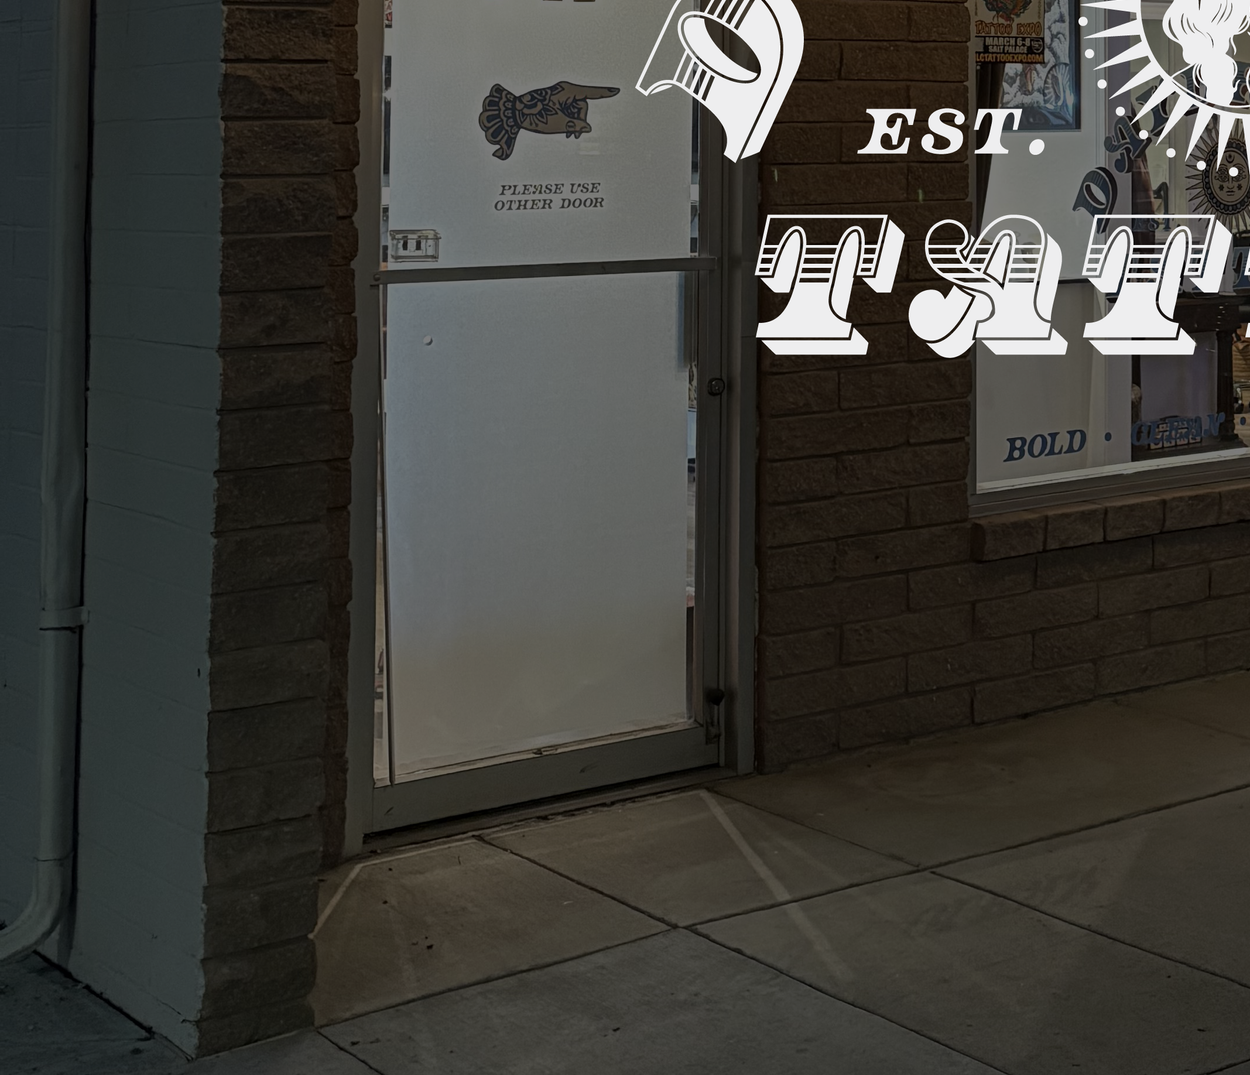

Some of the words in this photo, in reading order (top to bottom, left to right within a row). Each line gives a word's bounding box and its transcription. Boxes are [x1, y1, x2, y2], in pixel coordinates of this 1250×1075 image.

[975, 19, 1014, 35] TATTOO
[1016, 21, 1042, 36] EXPO
[985, 37, 1016, 46] MARCH
[1016, 37, 1031, 46] 6-8
[988, 45, 1004, 53] SALT
[1004, 46, 1028, 54] PALACE
[499, 184, 564, 196] PLEASE
[570, 182, 601, 194] USE
[494, 199, 553, 211] OTHER
[559, 197, 604, 209] DOOR
[1003, 429, 1087, 463] BOLD
[1131, 412, 1226, 446] CLEAN
